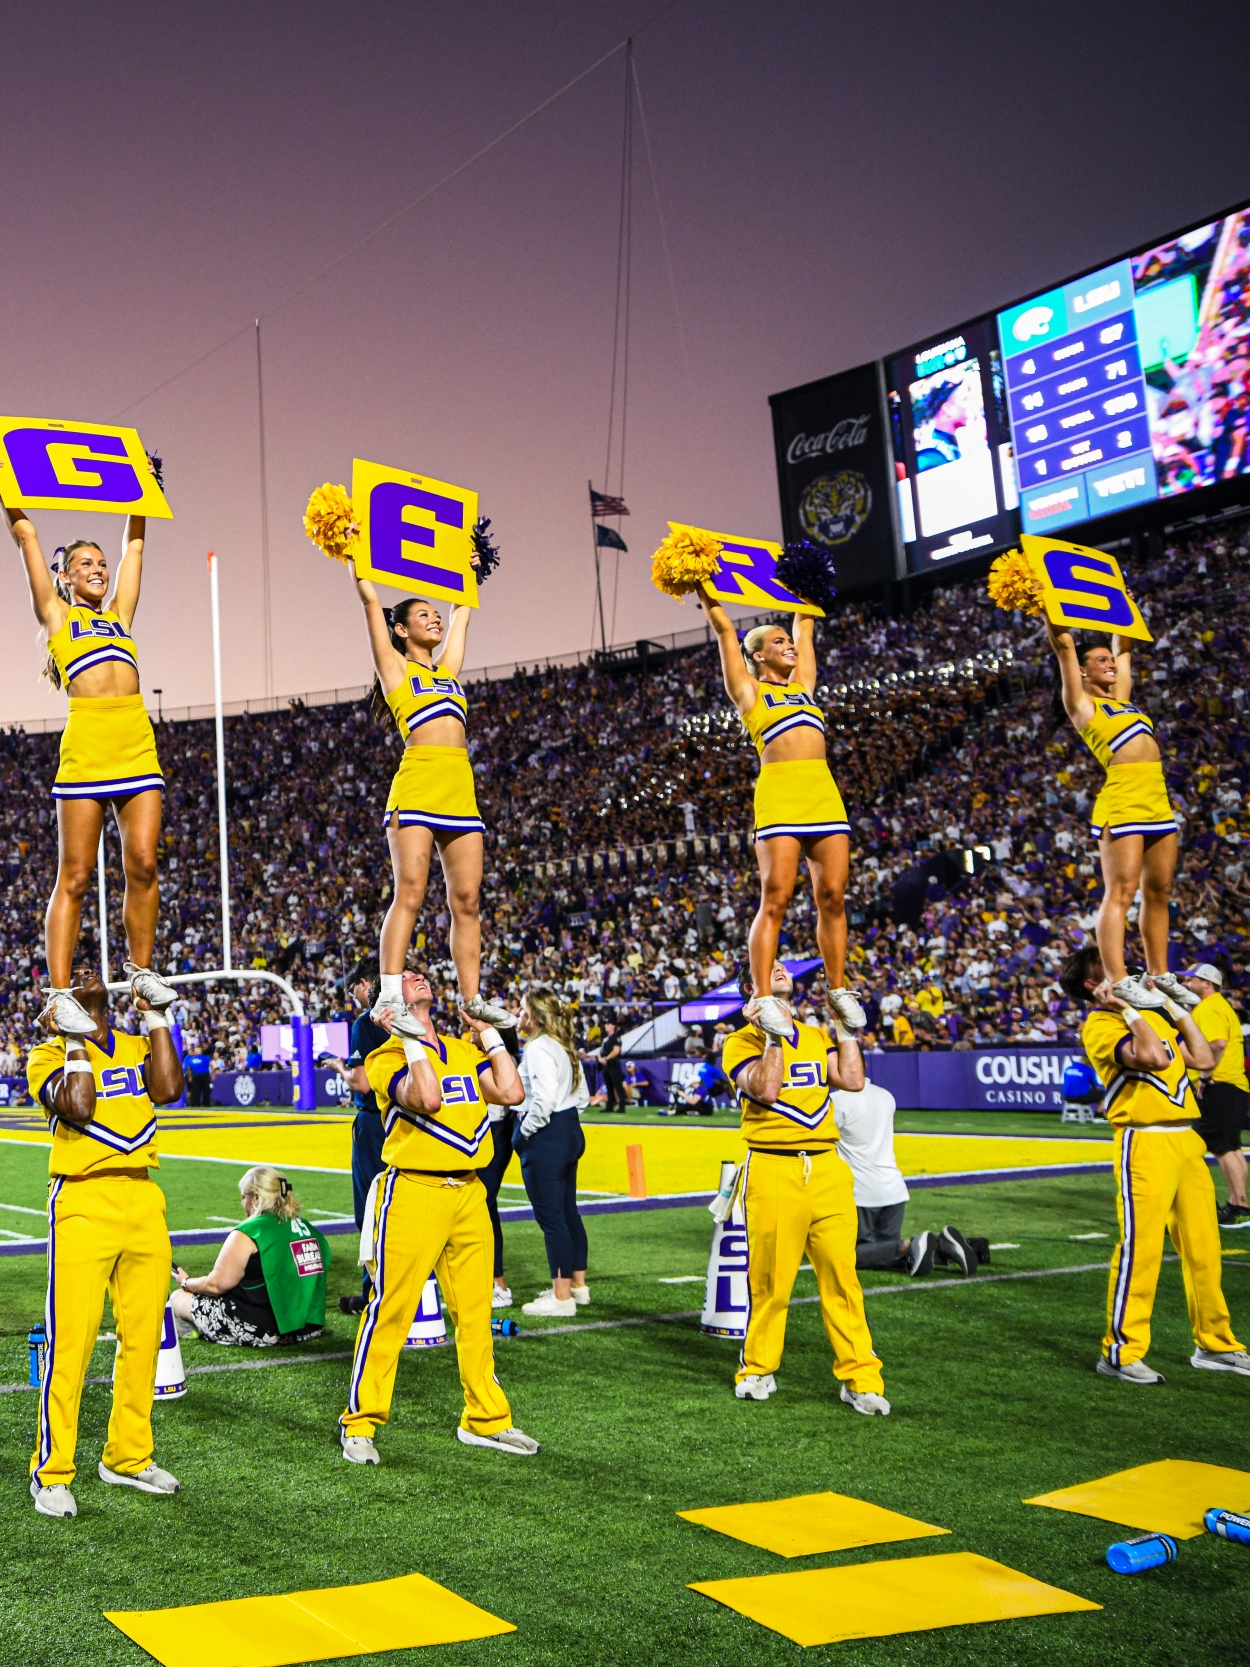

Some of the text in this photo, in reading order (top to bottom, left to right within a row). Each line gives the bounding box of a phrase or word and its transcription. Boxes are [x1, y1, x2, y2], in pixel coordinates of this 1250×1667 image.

[1073, 280, 1121, 313] LSU
[3, 428, 144, 502] G
[786, 413, 871, 464] Coca-Cola
[370, 482, 464, 592] E
[710, 541, 808, 605] R
[1044, 550, 1134, 626] S
[985, 1090, 1046, 1105] CASINO
[291, 1217, 311, 1237] 45
